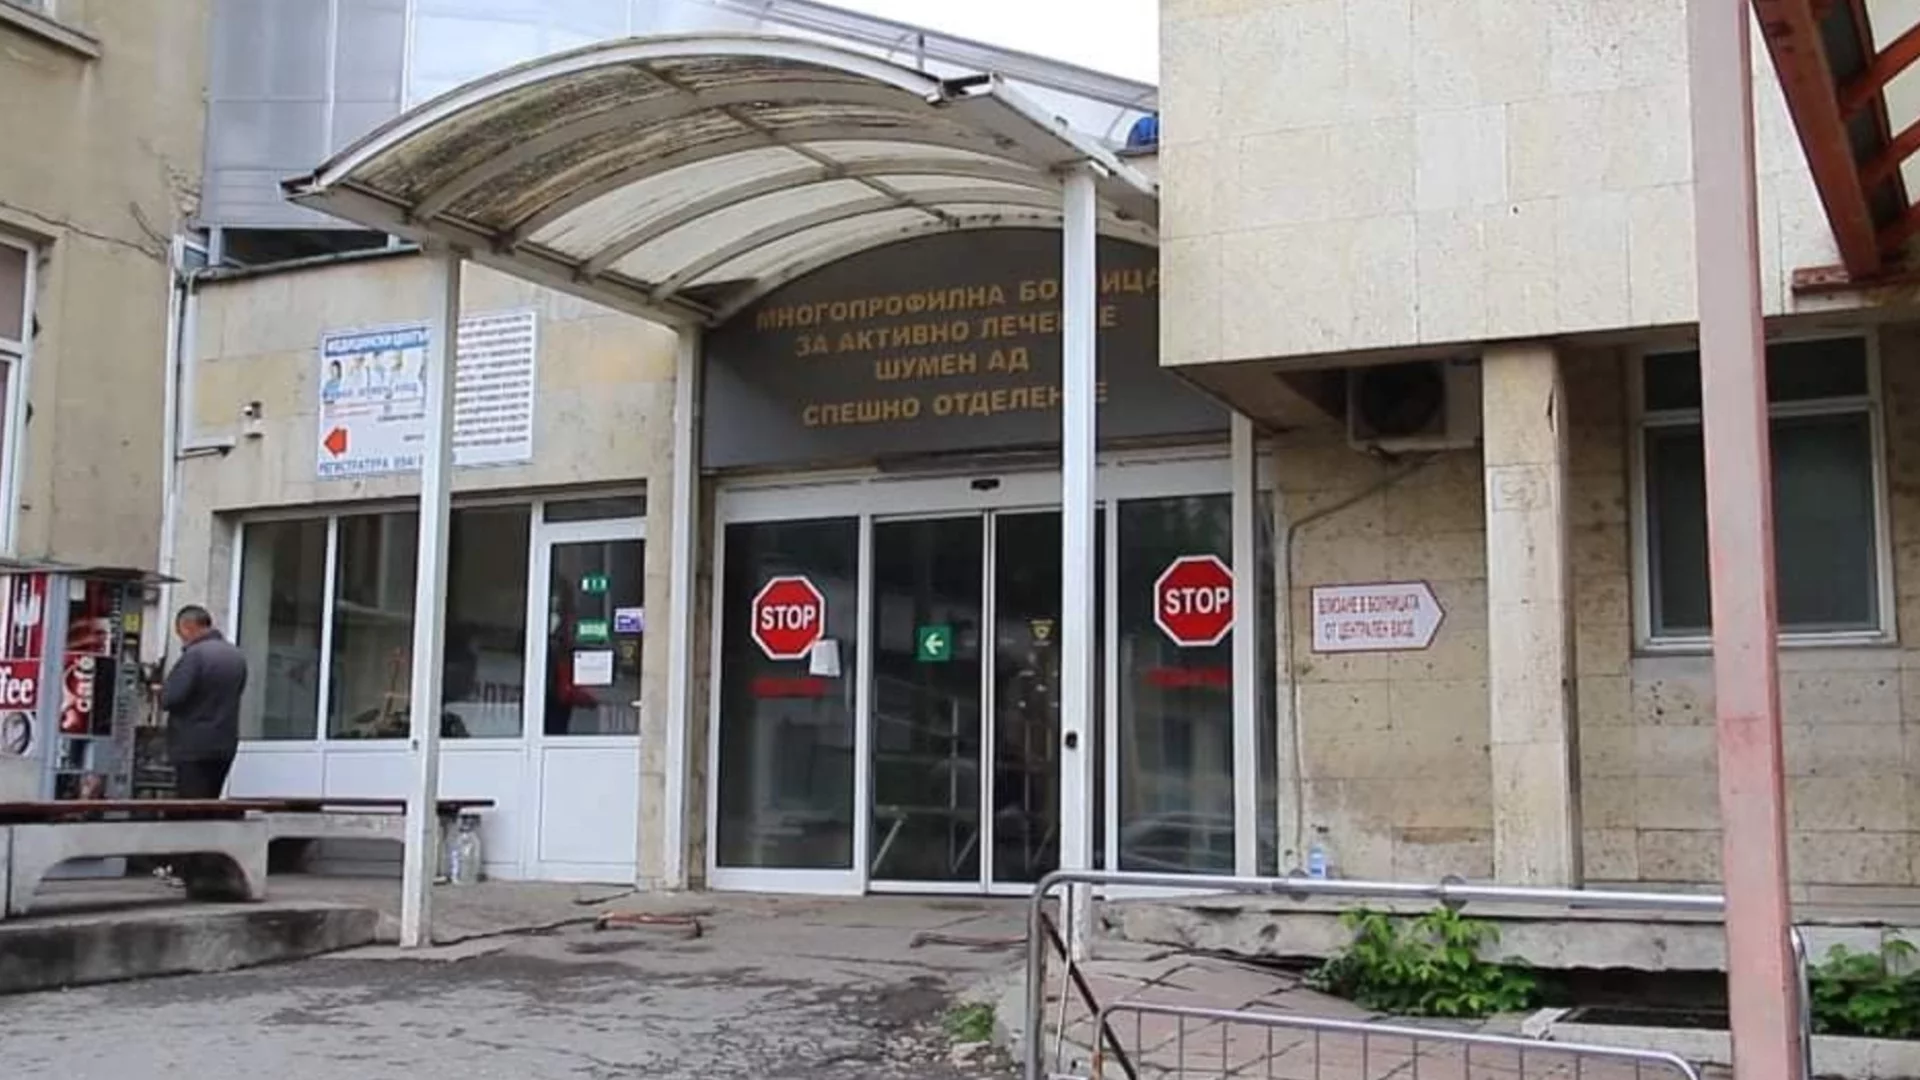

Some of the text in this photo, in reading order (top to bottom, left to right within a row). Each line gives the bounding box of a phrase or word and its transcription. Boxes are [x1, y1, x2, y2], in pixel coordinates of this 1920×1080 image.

[756, 268, 1160, 330] МНОГОПРОФИЛНА БОИЦА
[795, 304, 1118, 357] ЗА АКТИВНО ЛЕЧЕЕ
[876, 347, 1029, 380] ШУМЕН АД
[802, 382, 1108, 425] СПЕШНО ОТДЕЛЕНЕ
[761, 605, 816, 630] STOP
[1164, 586, 1231, 615] STOP
